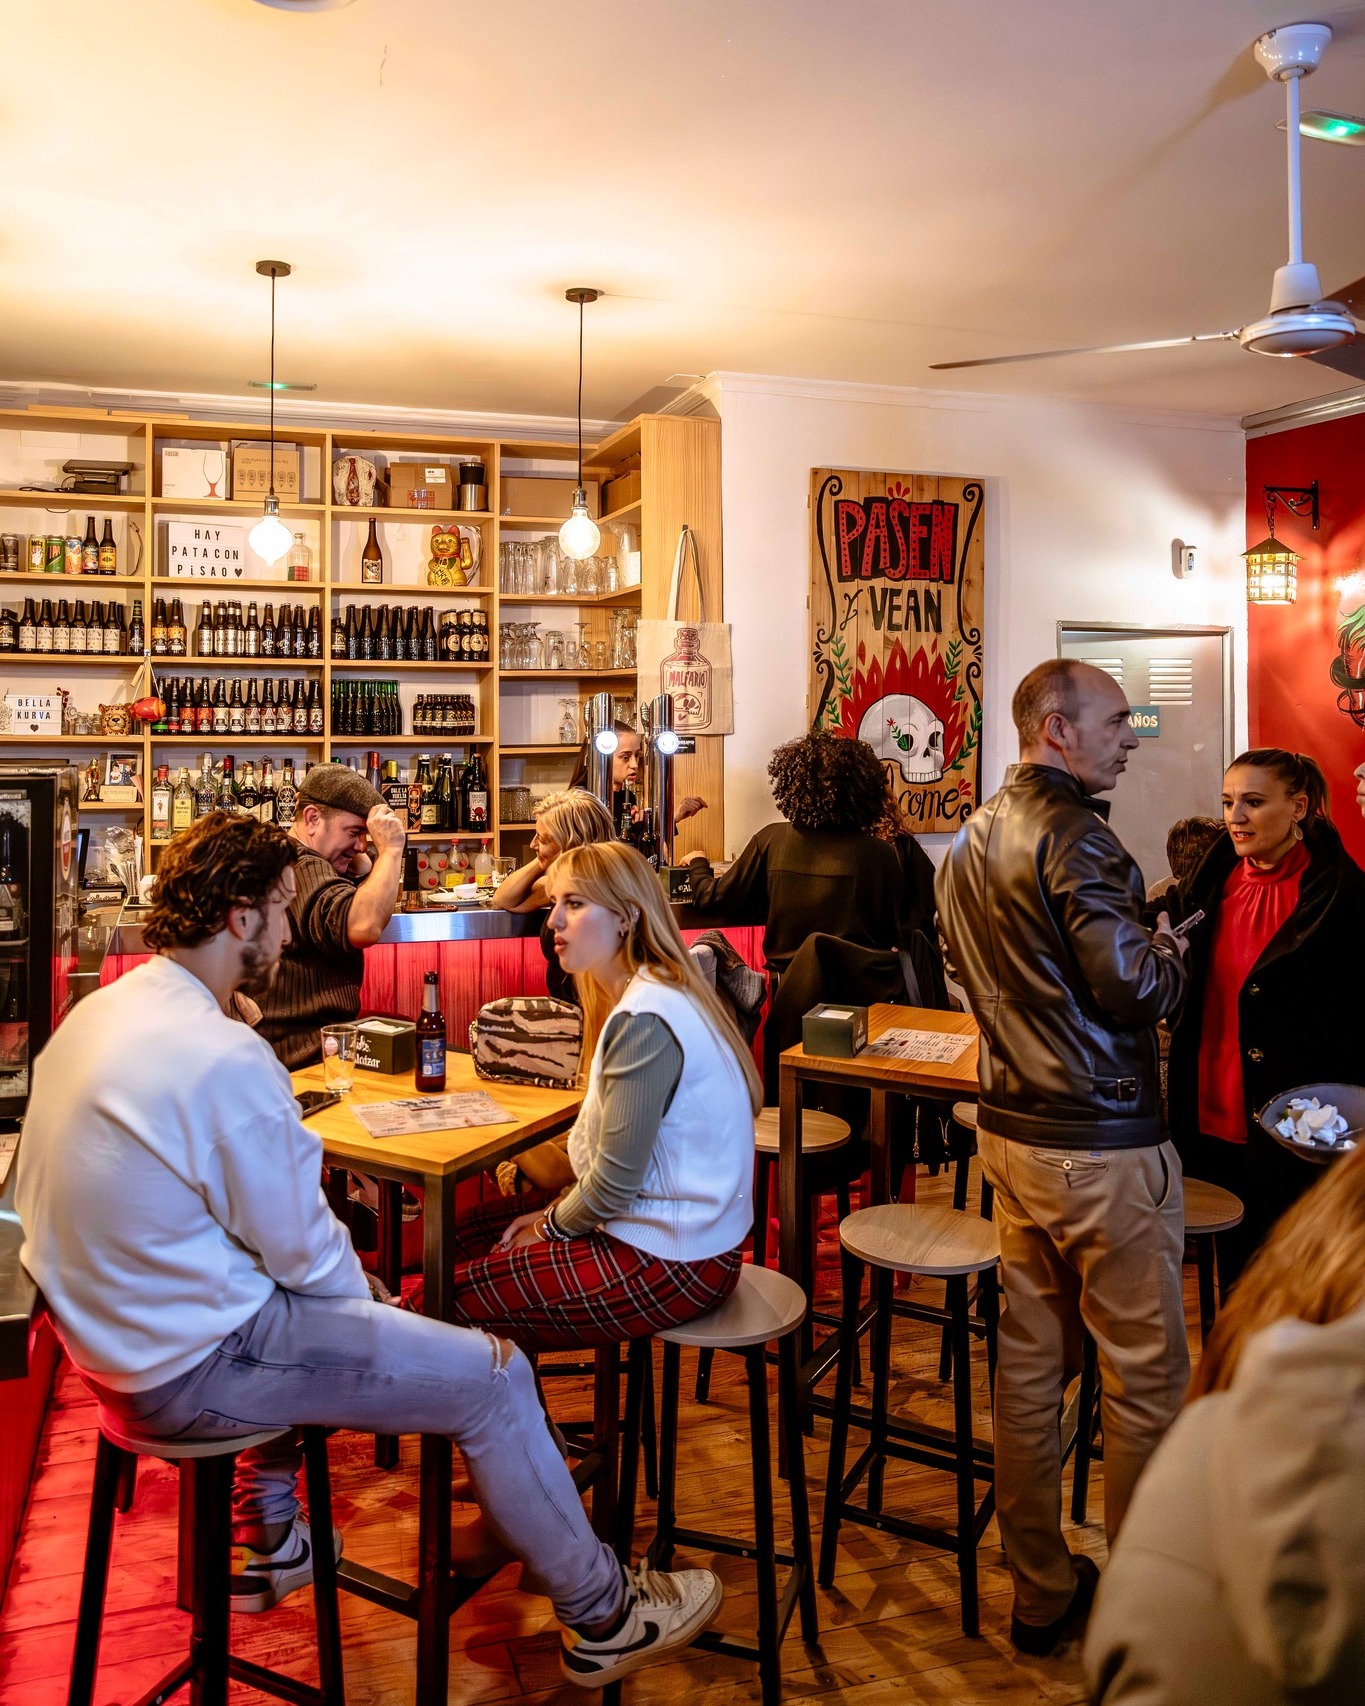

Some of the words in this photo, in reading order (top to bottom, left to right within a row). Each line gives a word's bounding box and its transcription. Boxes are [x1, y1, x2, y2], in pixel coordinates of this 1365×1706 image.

[194, 529, 221, 541] HAY
[837, 498, 956, 582] PASEN
[171, 545, 239, 560] PATACON
[868, 585, 943, 633] VEAN
[17, 698, 51, 707] BELLA
[17, 711, 51, 720] KURVA
[1127, 712, 1159, 729] AÑOS
